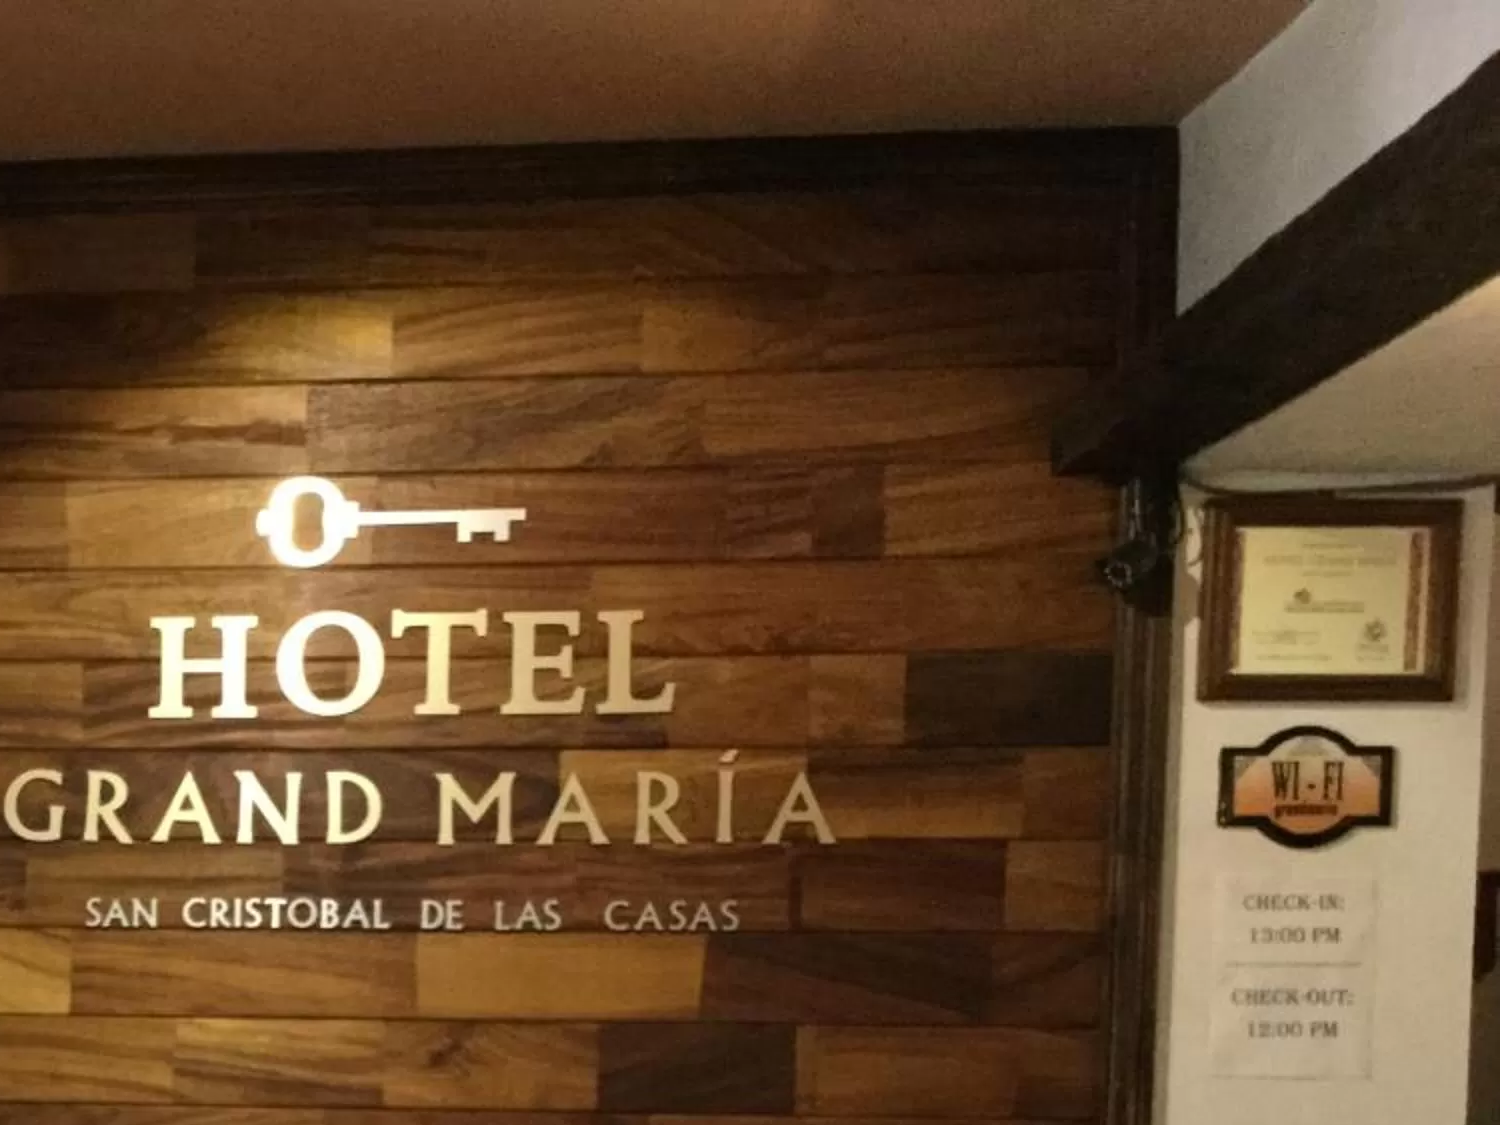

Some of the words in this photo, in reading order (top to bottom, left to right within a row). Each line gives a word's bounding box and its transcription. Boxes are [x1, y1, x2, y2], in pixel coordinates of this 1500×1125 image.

[148, 609, 676, 719] HOTEL
[3, 767, 382, 845] GRAND
[436, 750, 837, 846] MARÍA
[85, 897, 159, 930] SAN
[182, 896, 391, 931] CRISTOBAL
[420, 898, 463, 931] DE
[495, 898, 562, 931] LAS
[604, 899, 740, 932] CASAS
[1312, 927, 1341, 944] PM
[1310, 1020, 1339, 1038] PM
